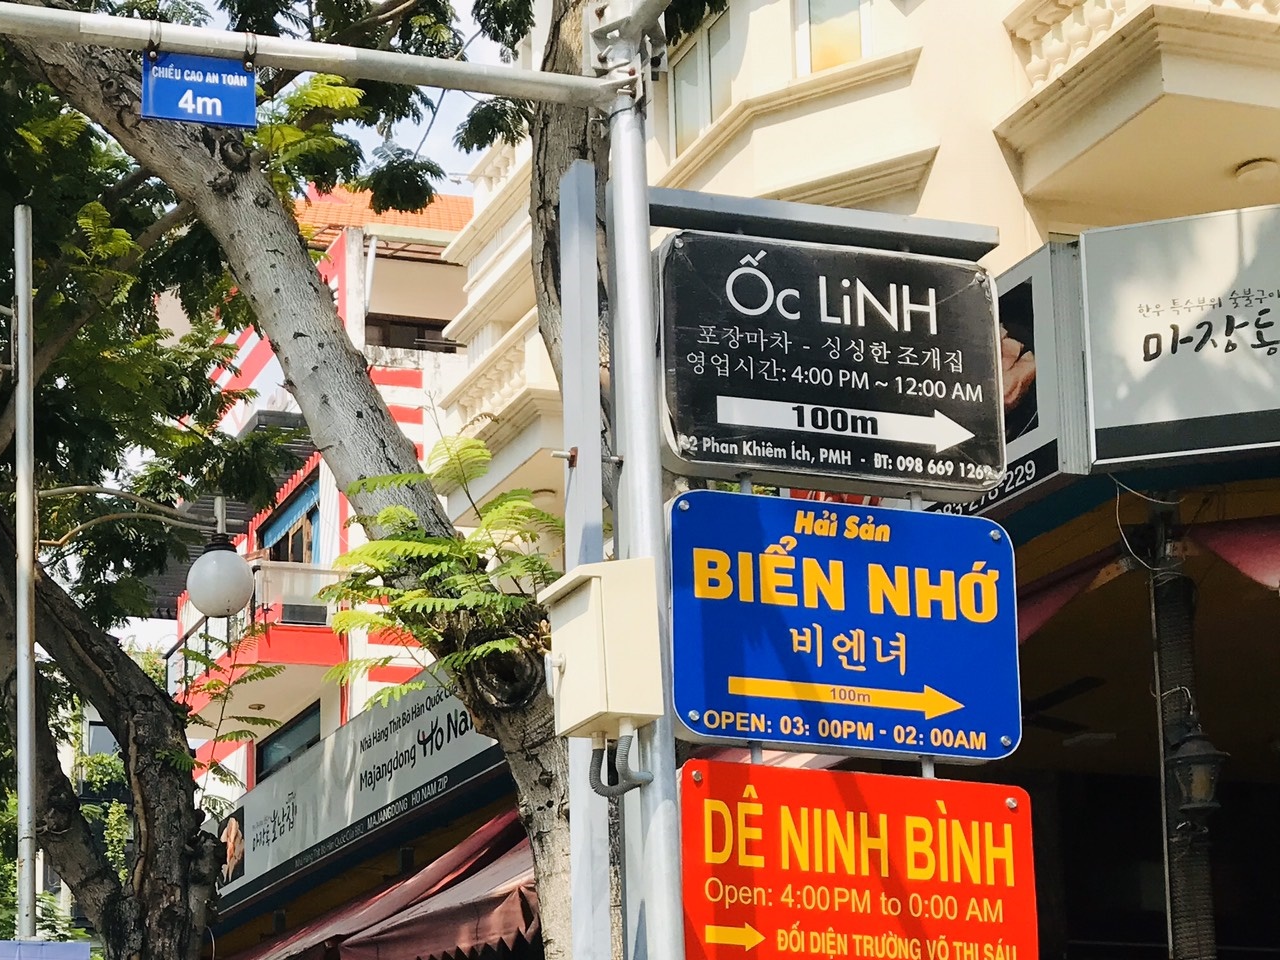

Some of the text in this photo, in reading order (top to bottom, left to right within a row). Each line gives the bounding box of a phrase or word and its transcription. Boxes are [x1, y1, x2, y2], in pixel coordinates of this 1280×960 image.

[152, 63, 247, 86] CHIỀU CAO AN TOÀN
[178, 89, 222, 116] 4m
[696, 324, 793, 353] 포장마차
[821, 336, 891, 363] 싱싱한
[897, 345, 964, 374] 조개집
[1142, 307, 1280, 362] 마장동
[686, 351, 787, 383] 영업시간:
[791, 367, 833, 387] 4:00
[839, 372, 870, 390] PM
[895, 376, 947, 399] 12:00
[952, 383, 984, 402] AM
[792, 404, 879, 435] 100m
[703, 437, 738, 455] Phan
[743, 440, 787, 458] Khiêm
[791, 441, 816, 464] Ích,
[820, 447, 851, 466] PMH
[873, 452, 893, 470] ĐT:
[896, 456, 924, 473] 098
[927, 459, 954, 476] 669
[794, 510, 892, 542] Hải Sản
[693, 535, 1000, 623] BIỂN NHỚ
[829, 687, 872, 703] 100m
[703, 709, 772, 734] OPEN:
[360, 744, 417, 791] Majangdong
[421, 783, 437, 801] NAM
[437, 775, 449, 789] ZIP
[704, 784, 1016, 887] DÊ NINH BÌNH
[704, 877, 773, 909] Open:
[880, 894, 902, 917] to
[908, 893, 959, 920] 0:00
[965, 897, 1004, 923] AM
[777, 921, 805, 953] ĐỐI
[810, 927, 848, 959] DIỆN
[852, 930, 922, 960] TRƯỜNG
